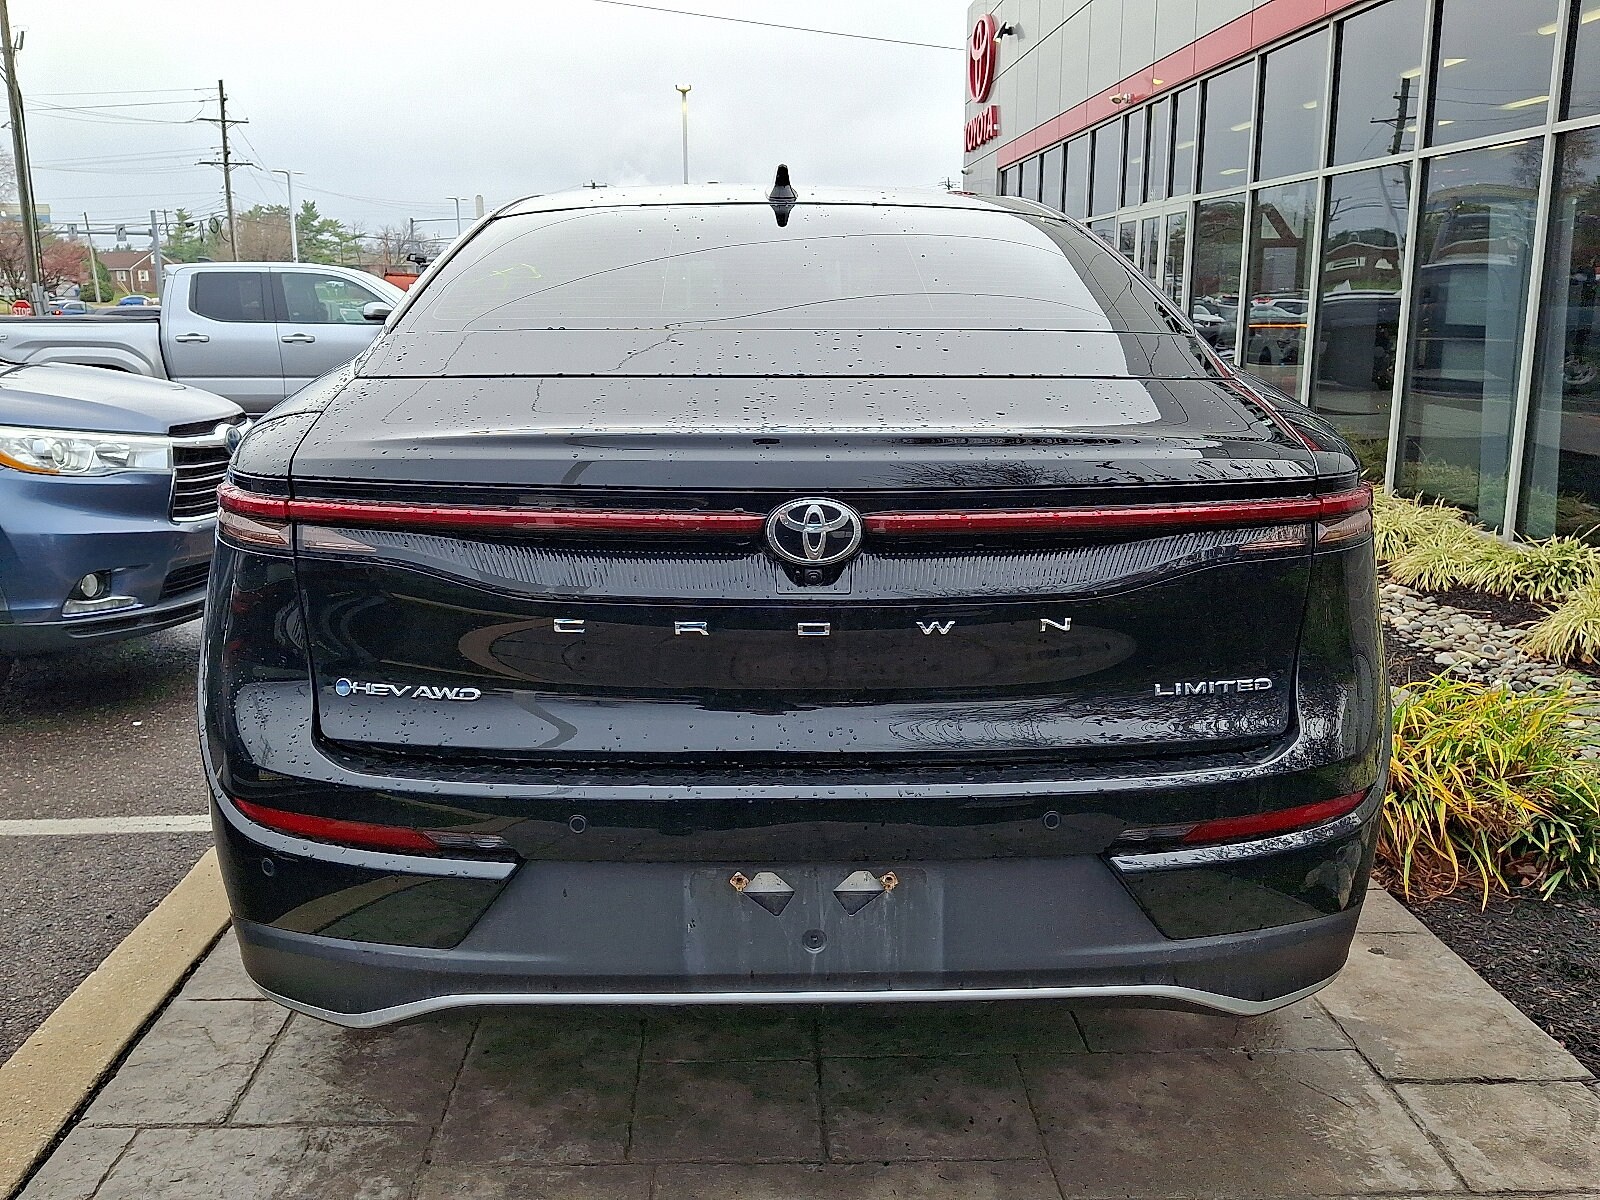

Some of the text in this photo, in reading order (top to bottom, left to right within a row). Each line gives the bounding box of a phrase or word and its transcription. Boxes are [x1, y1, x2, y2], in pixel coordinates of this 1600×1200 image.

[13, 307, 31, 316] STOP
[553, 617, 1072, 636] CROWN
[1154, 677, 1273, 697] LIMITED
